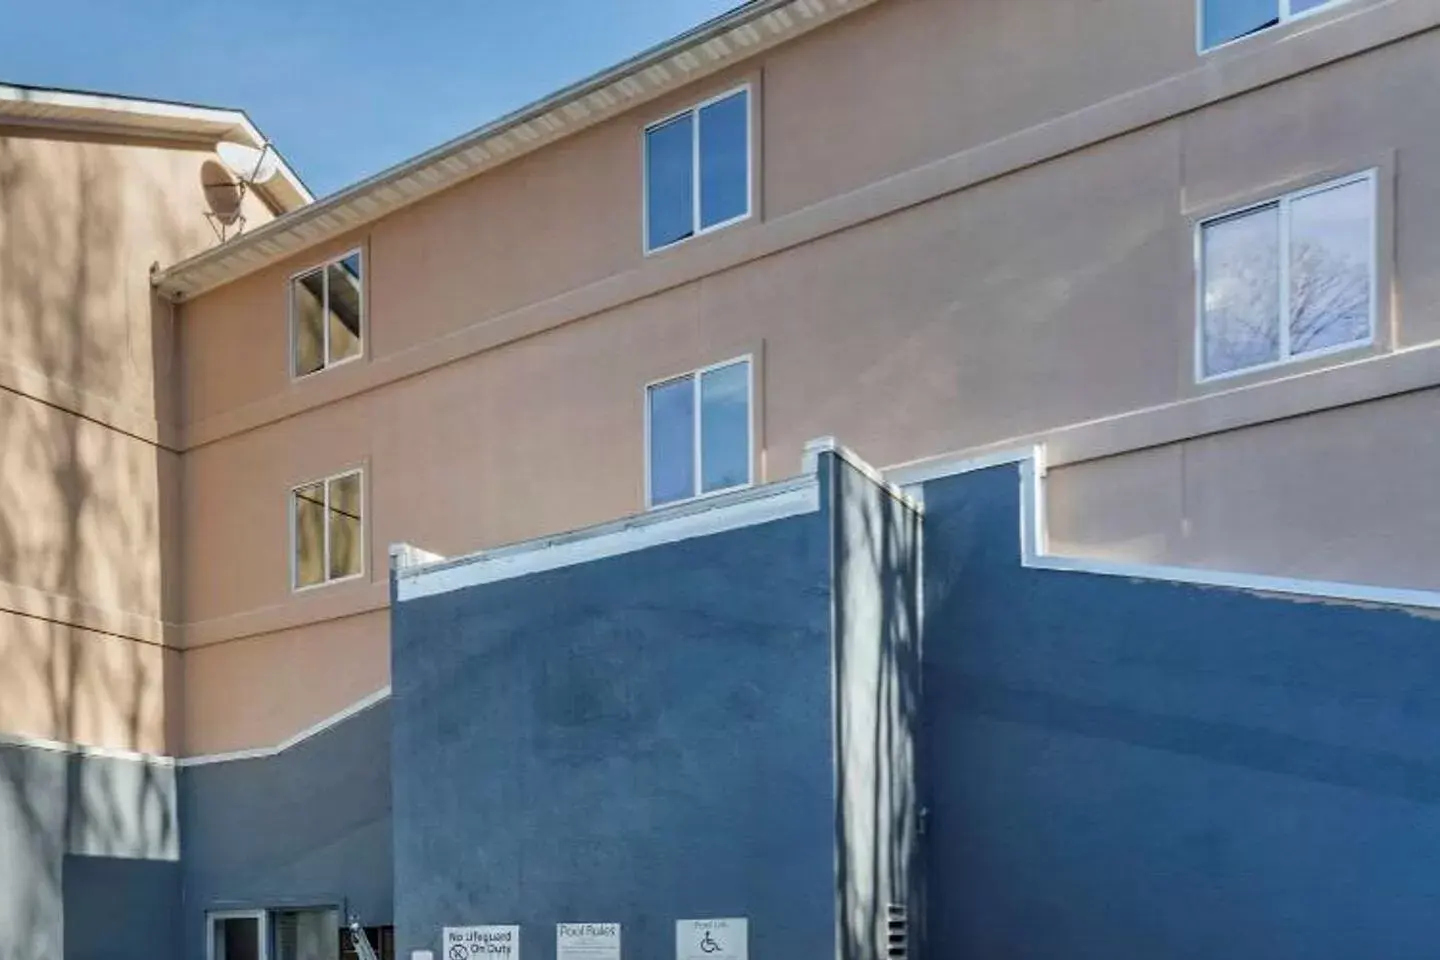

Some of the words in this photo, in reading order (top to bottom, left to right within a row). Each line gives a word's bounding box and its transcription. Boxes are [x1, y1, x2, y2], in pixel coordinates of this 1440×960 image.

[559, 924, 584, 937] Pool
[587, 923, 615, 936] Rules
[449, 933, 464, 942] No
[466, 931, 512, 943] Lifeguard
[471, 944, 486, 953] On
[487, 944, 512, 956] Duty
